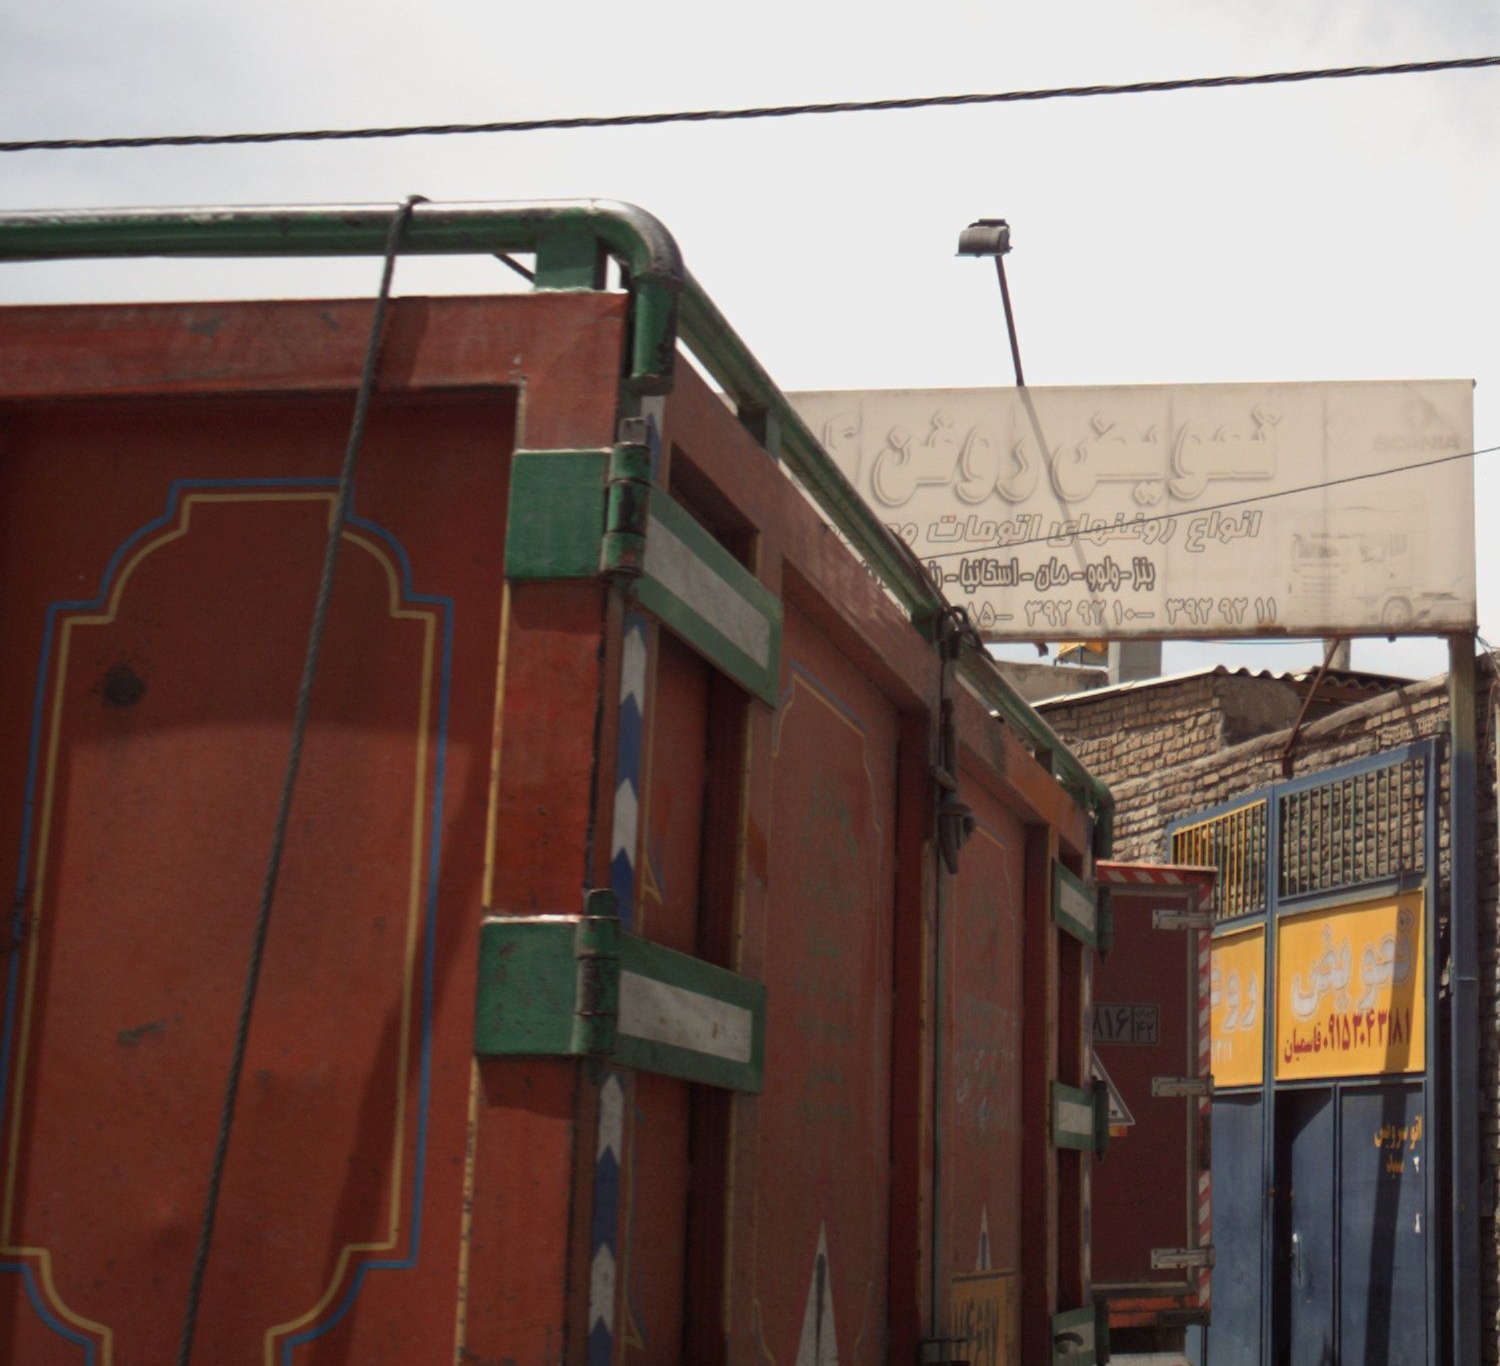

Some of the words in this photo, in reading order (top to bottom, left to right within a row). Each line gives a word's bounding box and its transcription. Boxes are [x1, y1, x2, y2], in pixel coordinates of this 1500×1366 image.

[870, 409, 1040, 507] روغن
[1050, 403, 1283, 506] تعویض
[927, 514, 1042, 545] اتومات
[1186, 510, 1262, 552] انواع
